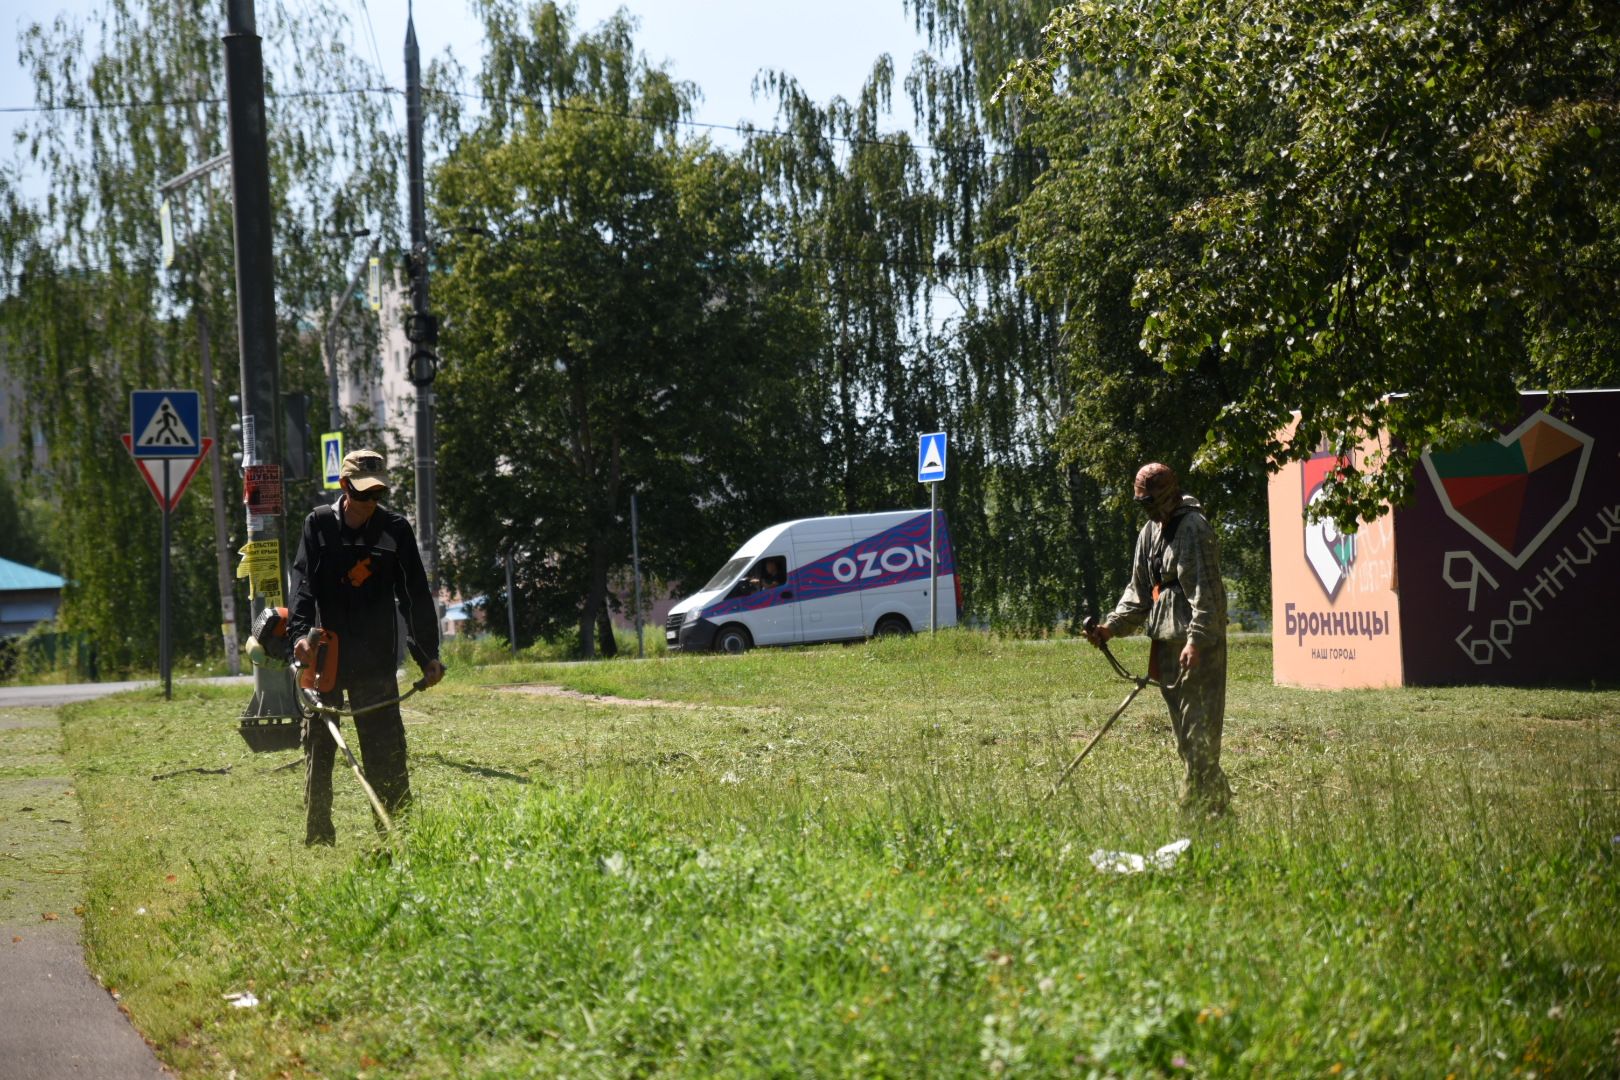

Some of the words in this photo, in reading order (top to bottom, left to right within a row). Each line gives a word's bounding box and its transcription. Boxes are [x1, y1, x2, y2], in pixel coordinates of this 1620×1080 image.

[832, 541, 940, 583] OZON
[1442, 550, 1500, 612] Я
[1285, 602, 1389, 647] Бронницы
[1311, 648, 1328, 660] НАШ
[1329, 648, 1356, 660] ГОРОД!
